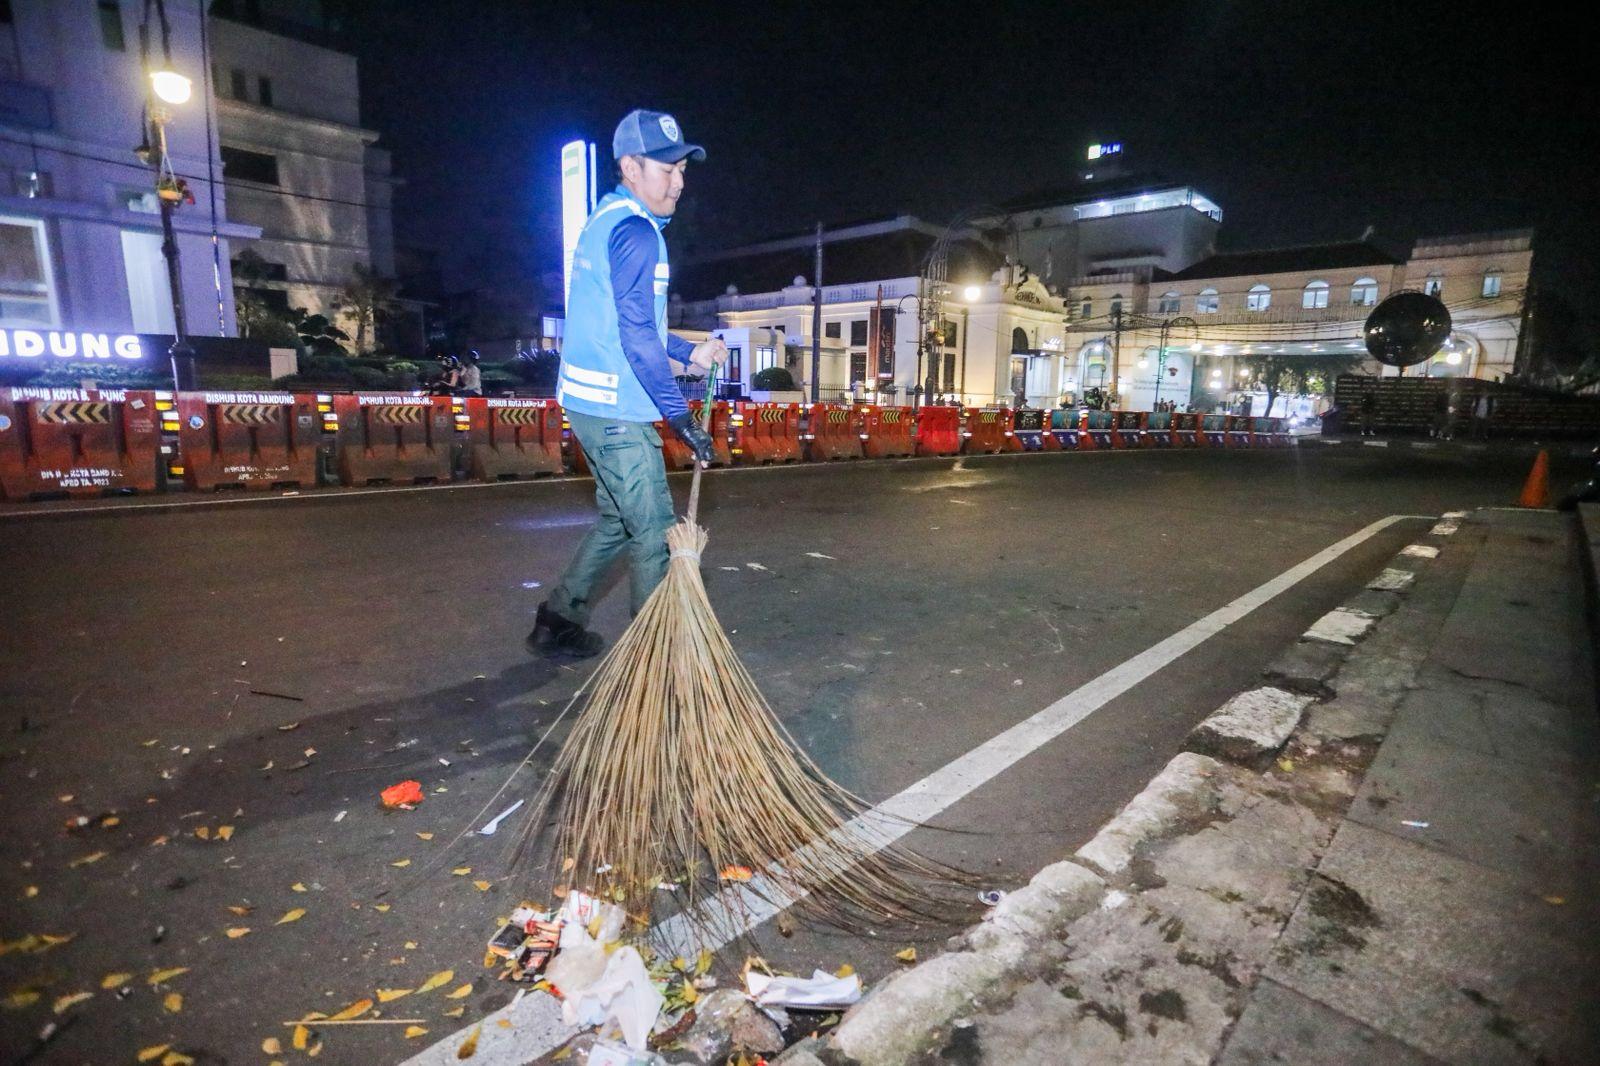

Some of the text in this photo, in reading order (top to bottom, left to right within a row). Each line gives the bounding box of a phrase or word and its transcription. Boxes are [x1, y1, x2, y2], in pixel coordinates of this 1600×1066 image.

[52, 388, 80, 401] KOTA
[80, 388, 126, 402] BUNG
[205, 393, 296, 405] DISHUB KOTA BANDUNG
[385, 396, 402, 405] KOTA
